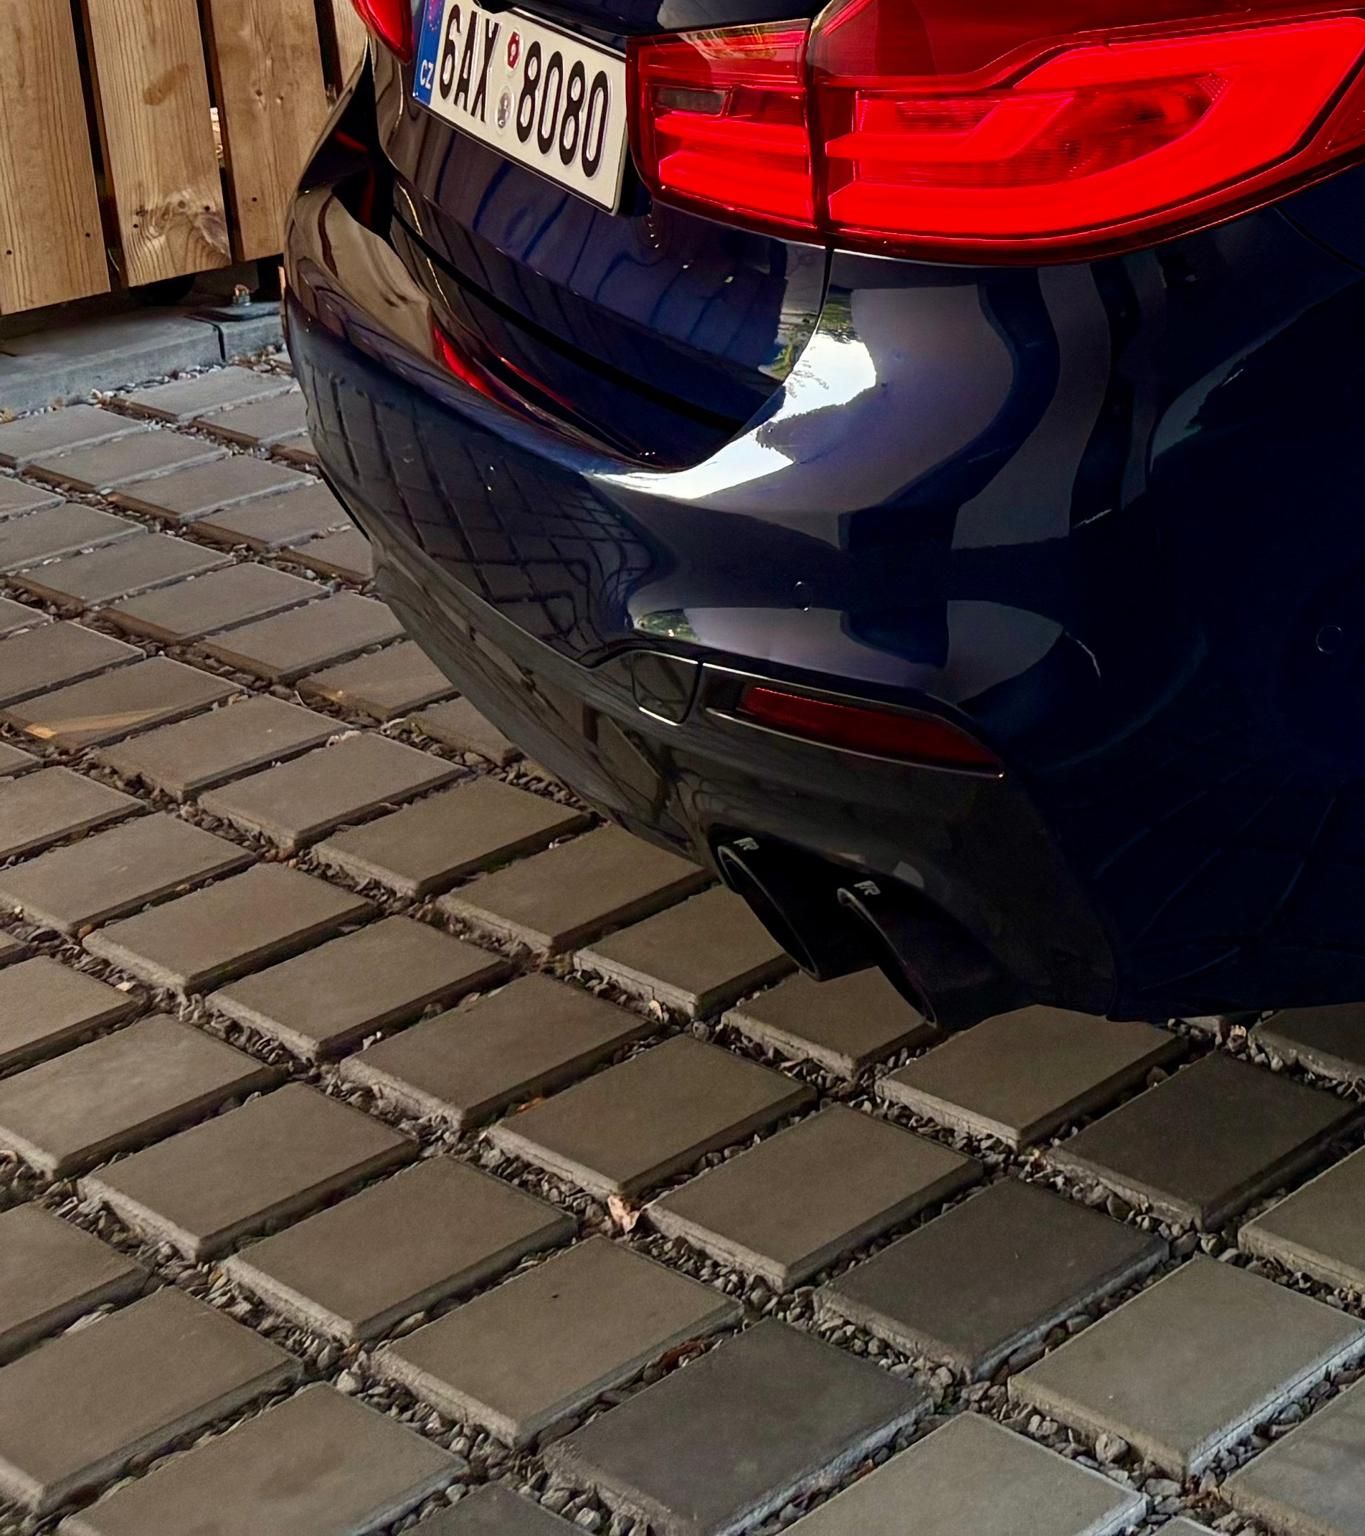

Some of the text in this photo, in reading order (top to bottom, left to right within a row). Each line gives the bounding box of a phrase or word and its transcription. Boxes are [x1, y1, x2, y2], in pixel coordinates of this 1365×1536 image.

[420, 58, 434, 91] CZ
[439, 4, 611, 179] 6AX 8080
